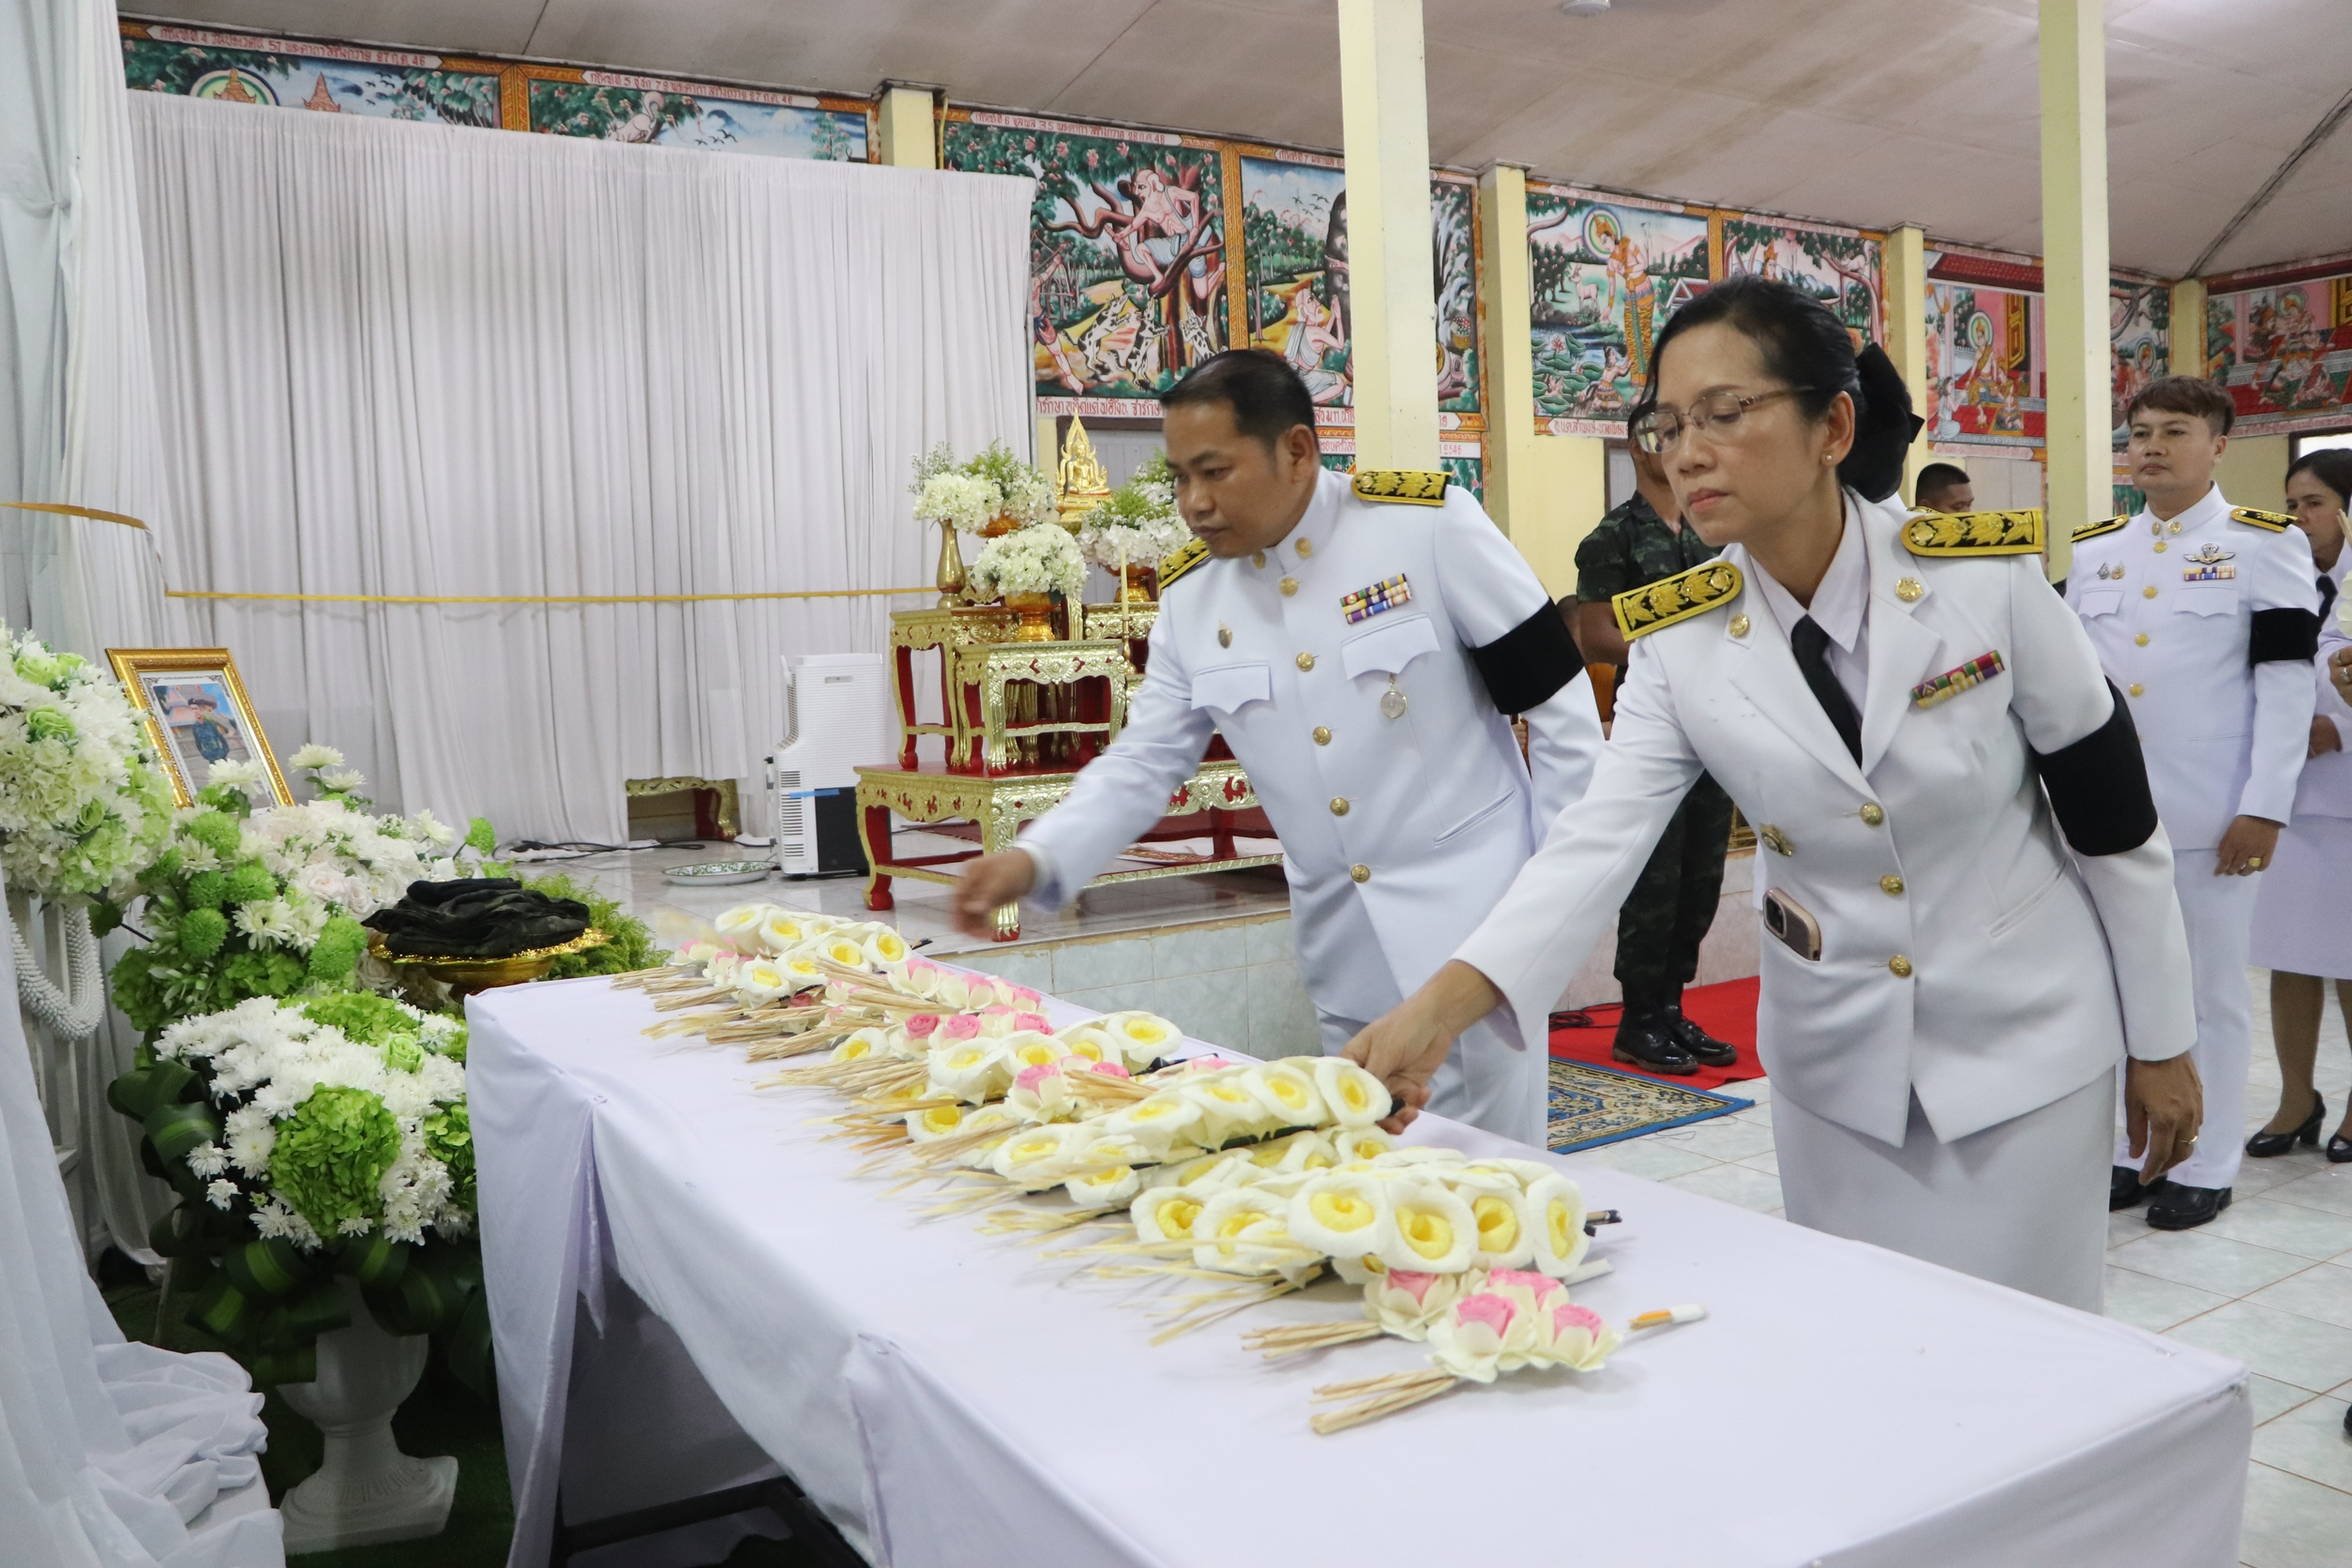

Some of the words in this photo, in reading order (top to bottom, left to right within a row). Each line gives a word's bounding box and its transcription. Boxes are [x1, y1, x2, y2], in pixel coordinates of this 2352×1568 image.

[201, 33, 206, 42] 4
[268, 40, 280, 52] 57
[412, 54, 425, 66] 46
[624, 76, 630, 84] 5
[1038, 120, 1053, 129] 35
